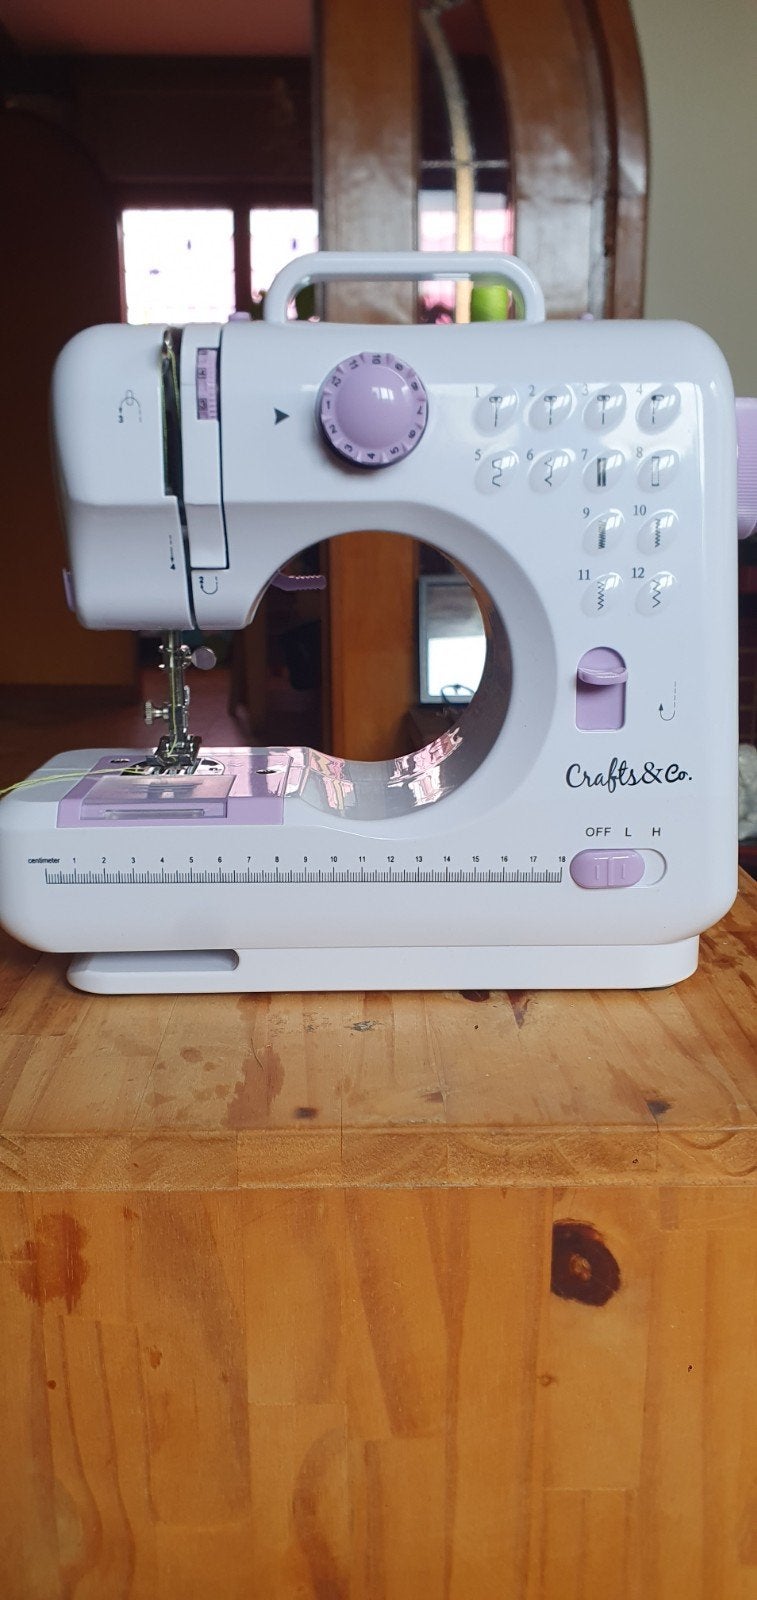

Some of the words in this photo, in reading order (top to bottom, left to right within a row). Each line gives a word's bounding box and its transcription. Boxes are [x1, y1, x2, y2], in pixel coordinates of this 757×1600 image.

[372, 355, 381, 364] 10
[331, 376, 341, 387] 12
[474, 386, 479, 397] 1
[529, 385, 535, 397] 2
[582, 384, 589, 396] 3
[636, 383, 643, 395] 4
[326, 400, 330, 410] 1
[329, 424, 337, 434] 2
[344, 444, 353, 452] 3
[475, 449, 481, 461] 5
[526, 449, 534, 460] 6
[581, 448, 588, 460] 7
[636, 447, 643, 458] 8
[582, 507, 590, 518] 9
[633, 504, 647, 516] 10
[579, 569, 590, 581] 11
[632, 567, 645, 578] 12
[566, 757, 693, 793] Crafts&Co.
[585, 827, 611, 837] OFF
[625, 827, 632, 837] L
[652, 827, 661, 837] H
